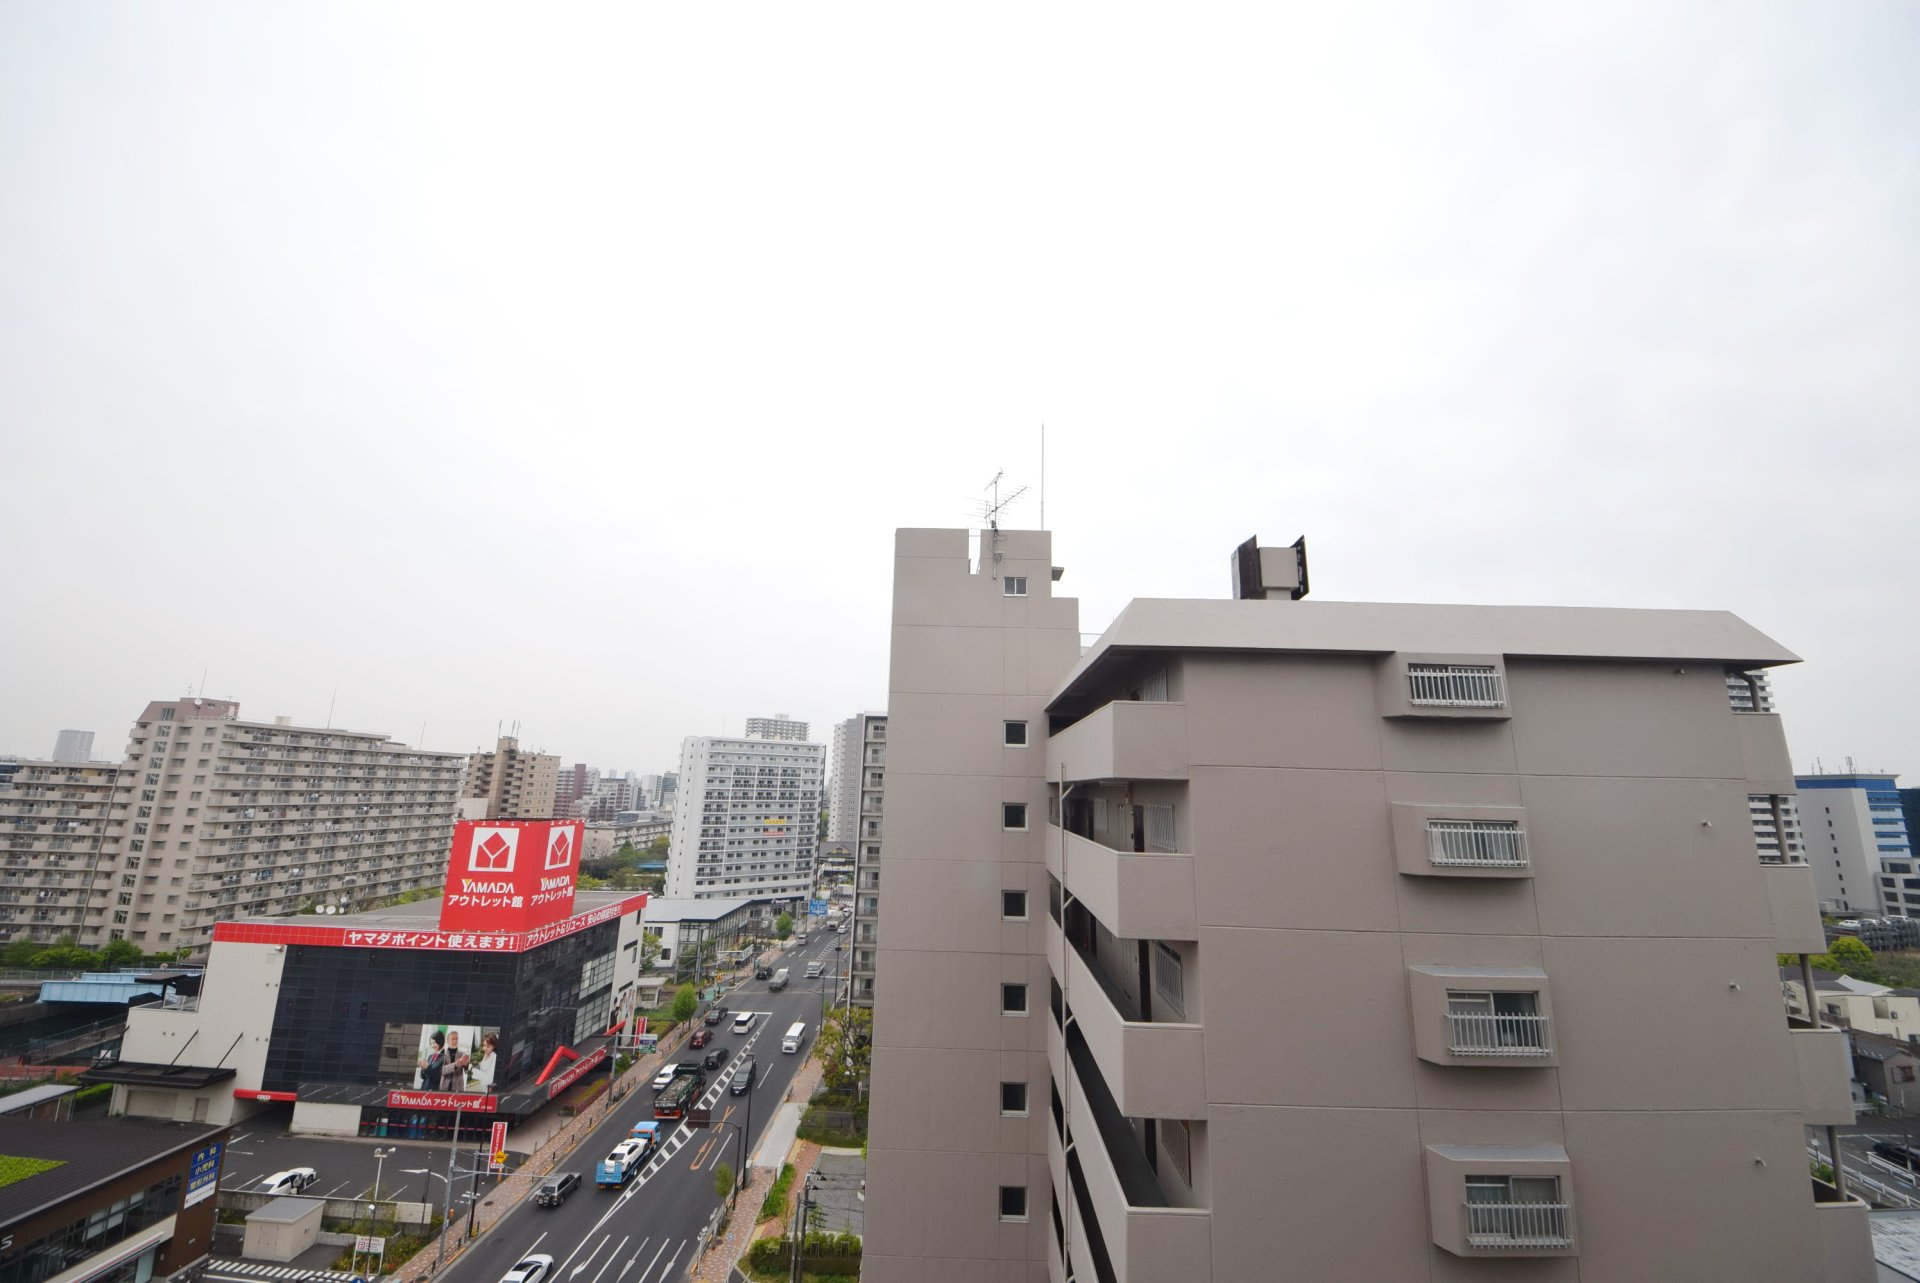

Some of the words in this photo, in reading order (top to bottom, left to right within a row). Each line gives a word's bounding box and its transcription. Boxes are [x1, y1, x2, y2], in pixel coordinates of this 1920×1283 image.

[462, 879, 514, 893] YAMADA
[541, 875, 570, 891] YAMADA
[448, 895, 523, 908] アウトレット館
[531, 886, 574, 906] アウトレット館
[401, 1095, 432, 1105] YAMADA
[433, 1098, 480, 1109] アウトレット館
